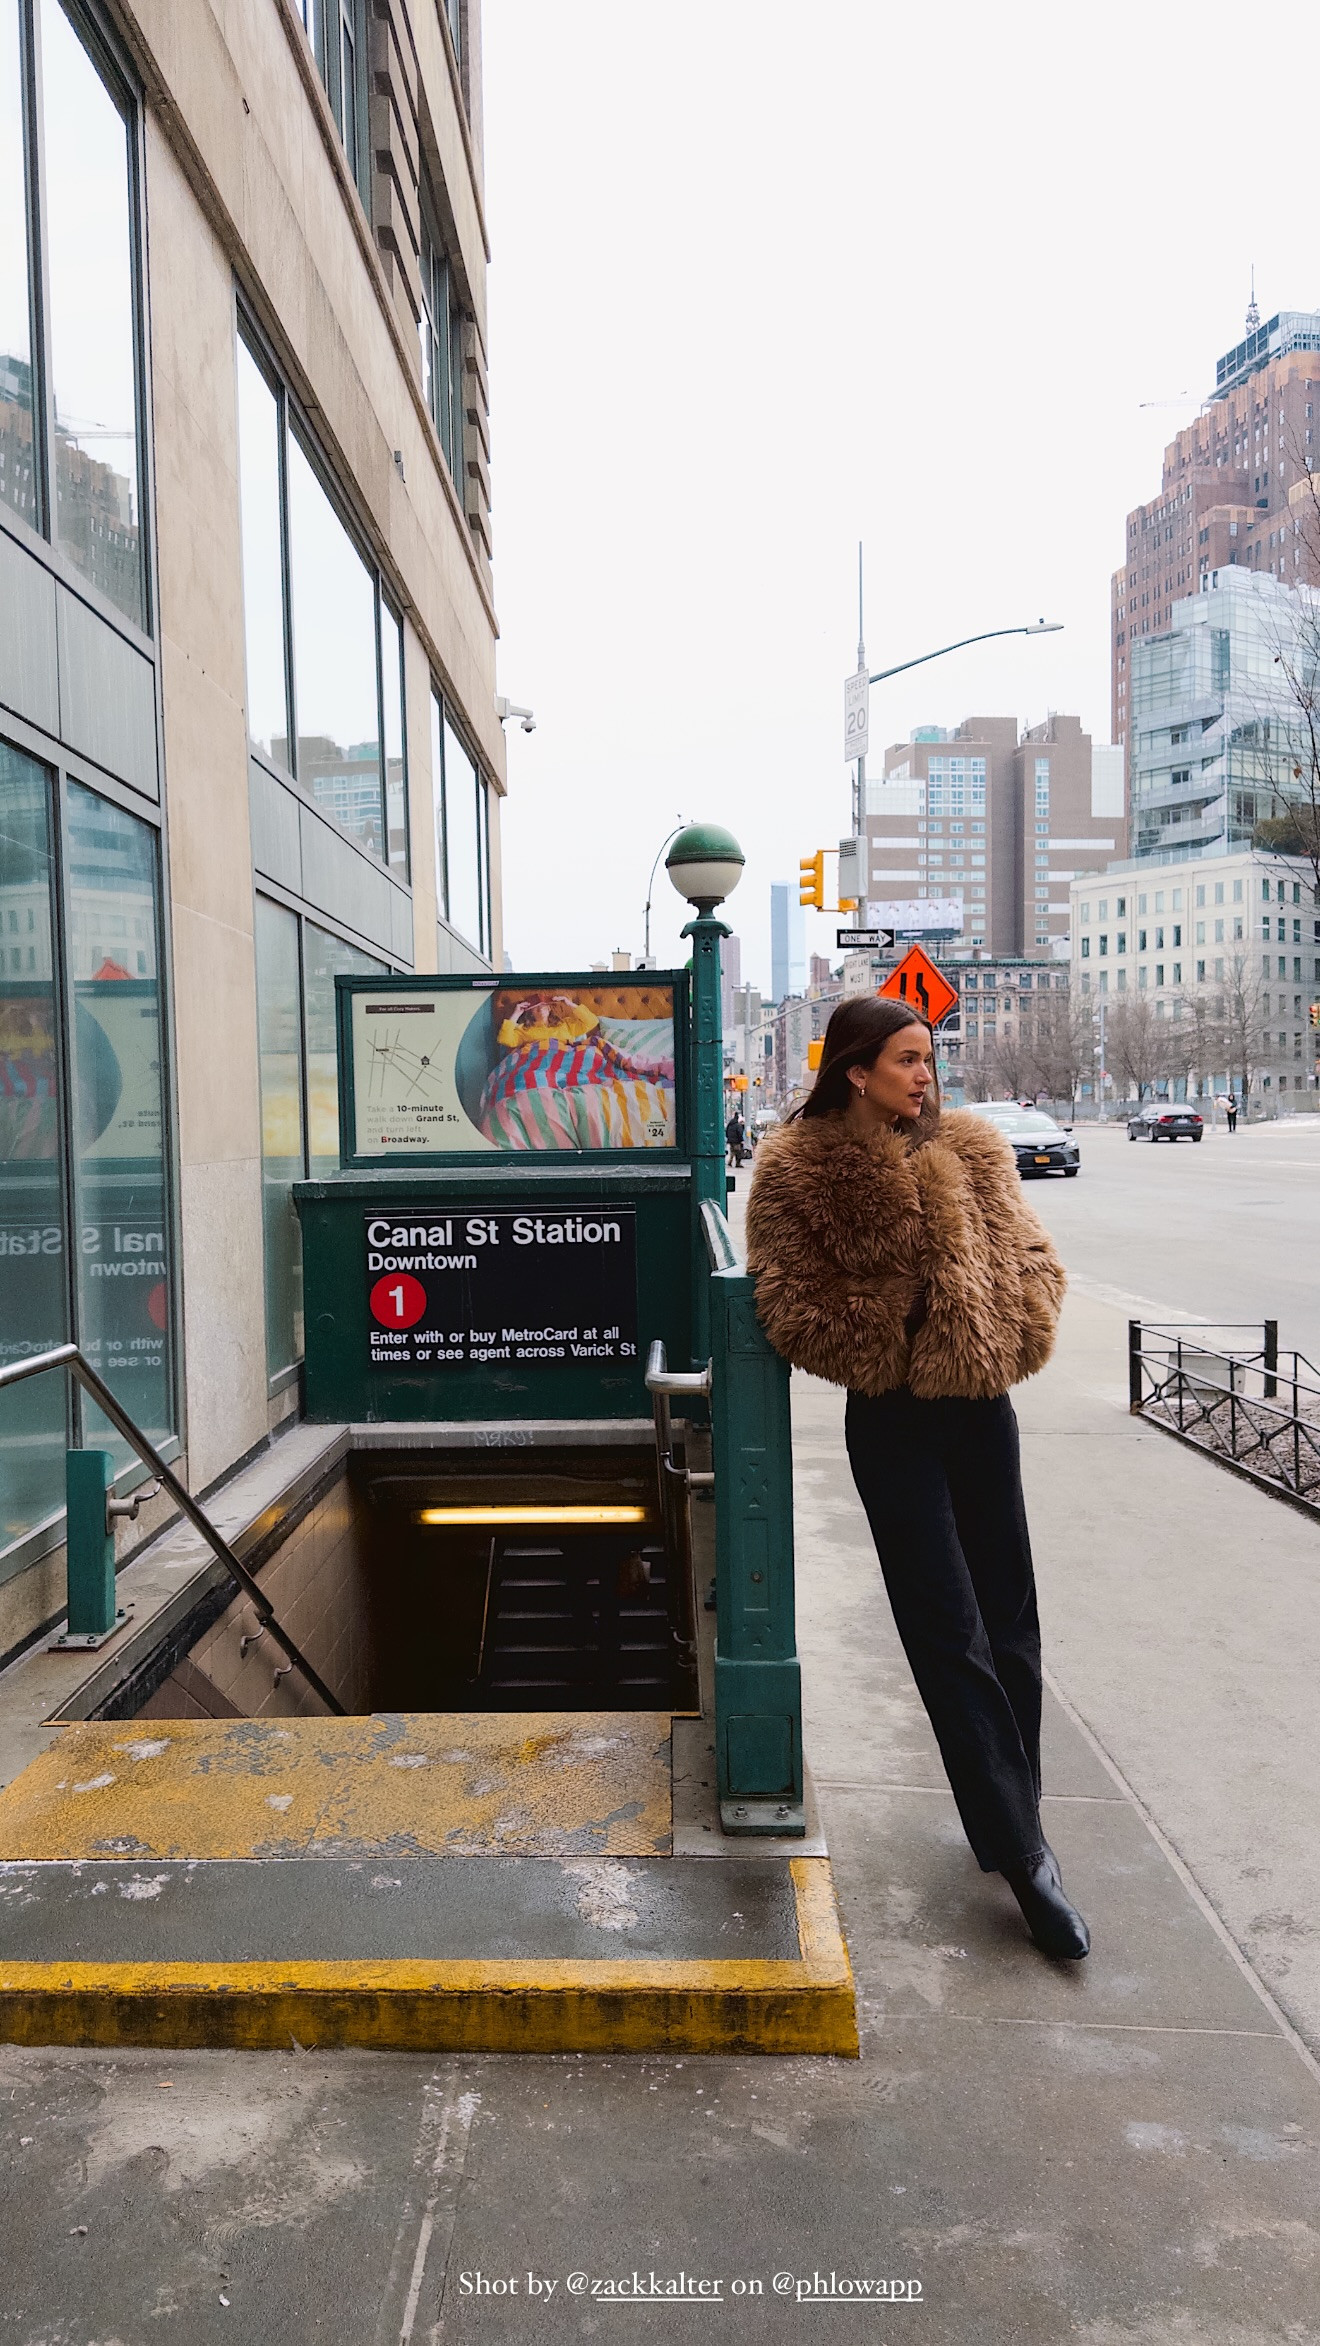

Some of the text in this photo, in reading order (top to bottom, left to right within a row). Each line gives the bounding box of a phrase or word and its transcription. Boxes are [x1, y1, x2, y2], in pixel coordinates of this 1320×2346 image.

[846, 676, 866, 693] SPEED
[848, 690, 864, 706] LIMIT
[847, 707, 866, 735] 20
[844, 934, 886, 943] ONE WAY
[850, 973, 864, 984] MUST
[367, 1105, 386, 1113] Take
[397, 1104, 444, 1112] 10-minute
[366, 1115, 387, 1123] walk
[389, 1115, 413, 1123] down
[447, 1114, 460, 1123] St,
[367, 1125, 383, 1133] and
[648, 1128, 664, 1137] '24
[381, 1135, 430, 1144] Broadway.
[367, 1216, 621, 1248] Canal St Station
[368, 1252, 477, 1271] Downtown
[388, 1285, 404, 1317] 1
[370, 1326, 619, 1345] Enter with or buy MetroCard at all
[371, 1342, 637, 1362] times or see agent across Varick St
